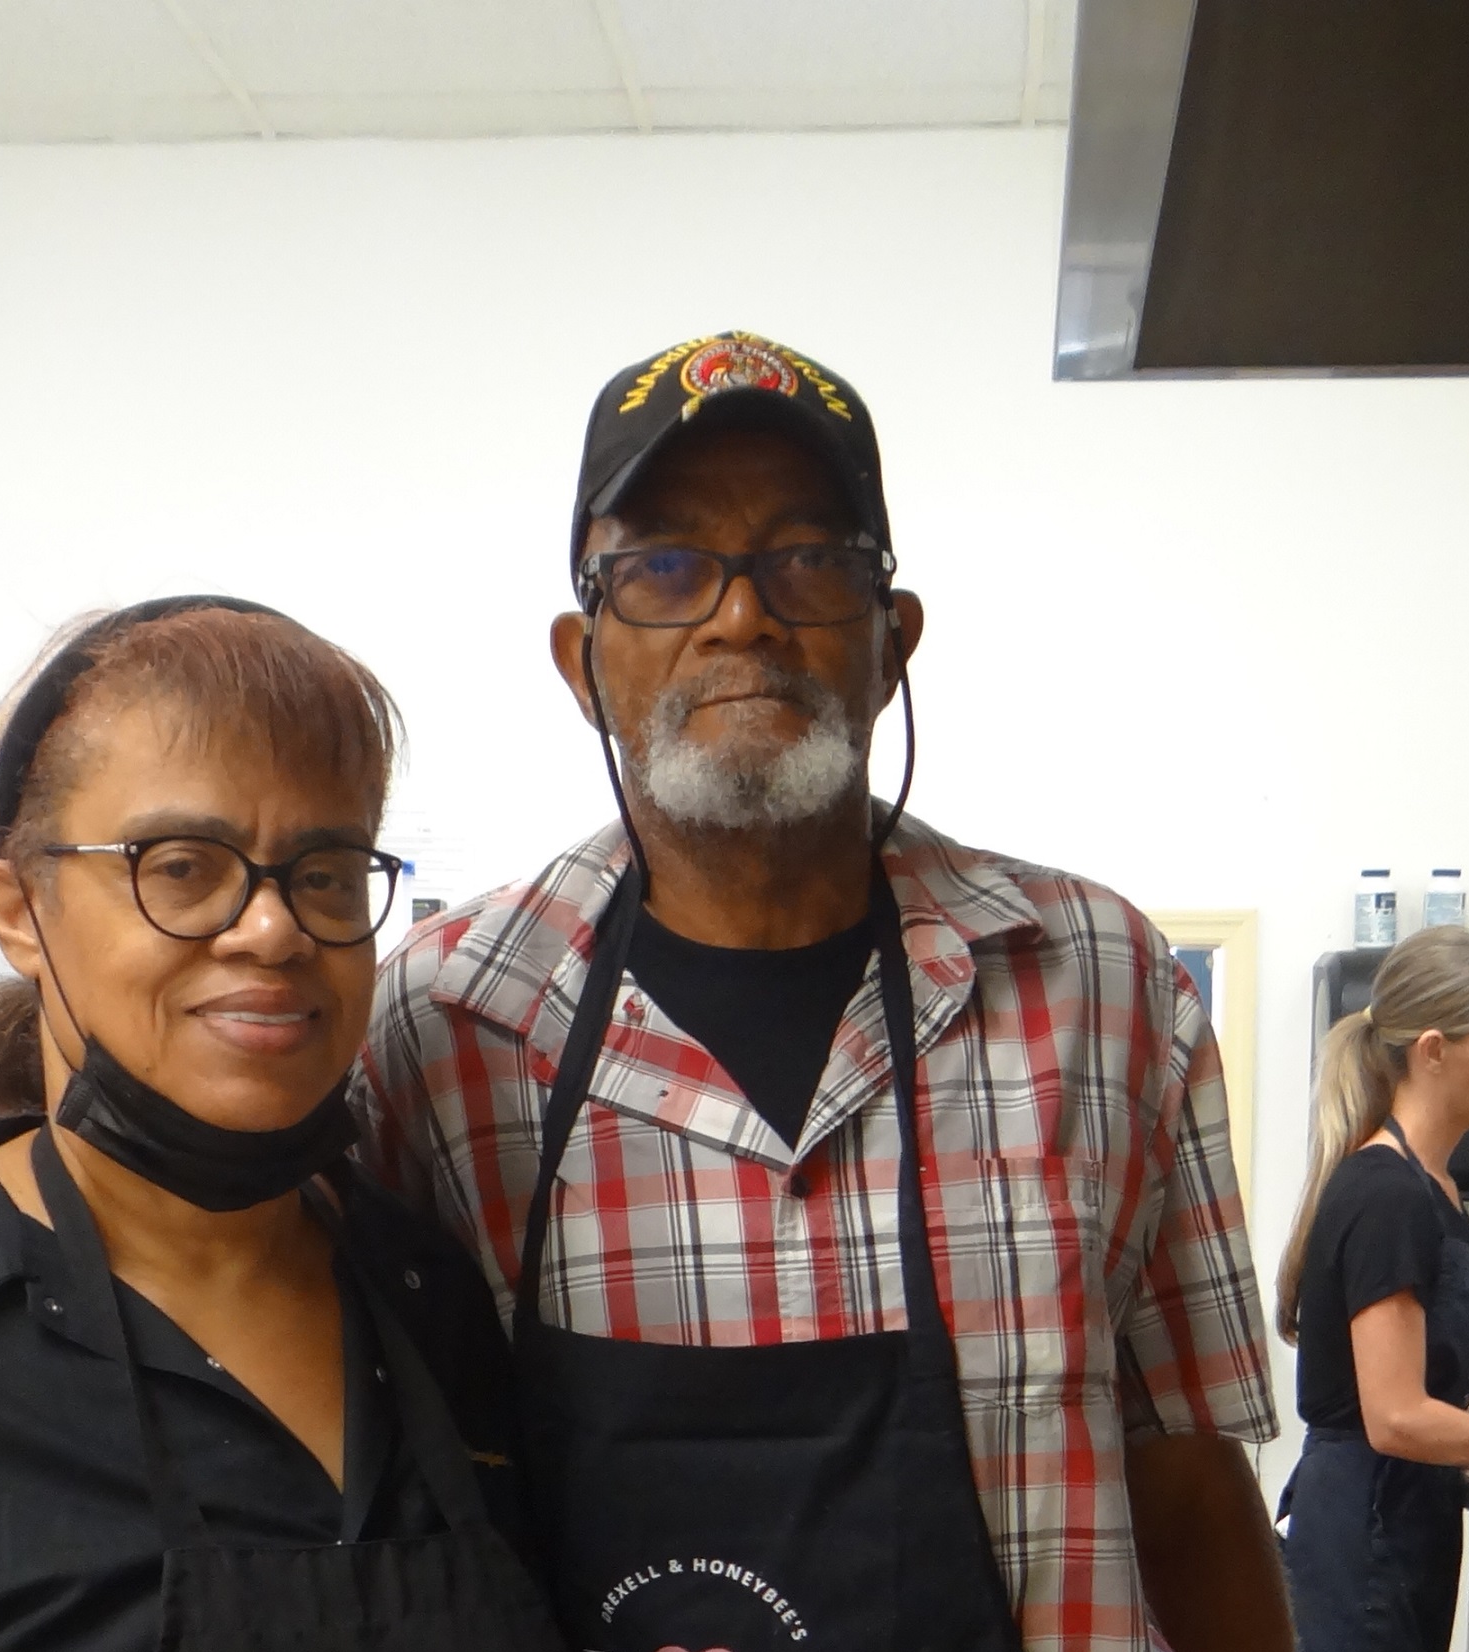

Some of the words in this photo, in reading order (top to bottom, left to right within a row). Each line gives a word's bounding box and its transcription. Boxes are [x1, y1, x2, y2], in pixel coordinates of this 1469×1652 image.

[601, 1565, 661, 1624] DREXELL
[668, 1559, 683, 1573] &
[692, 1558, 808, 1641] HONEYBEE'S
